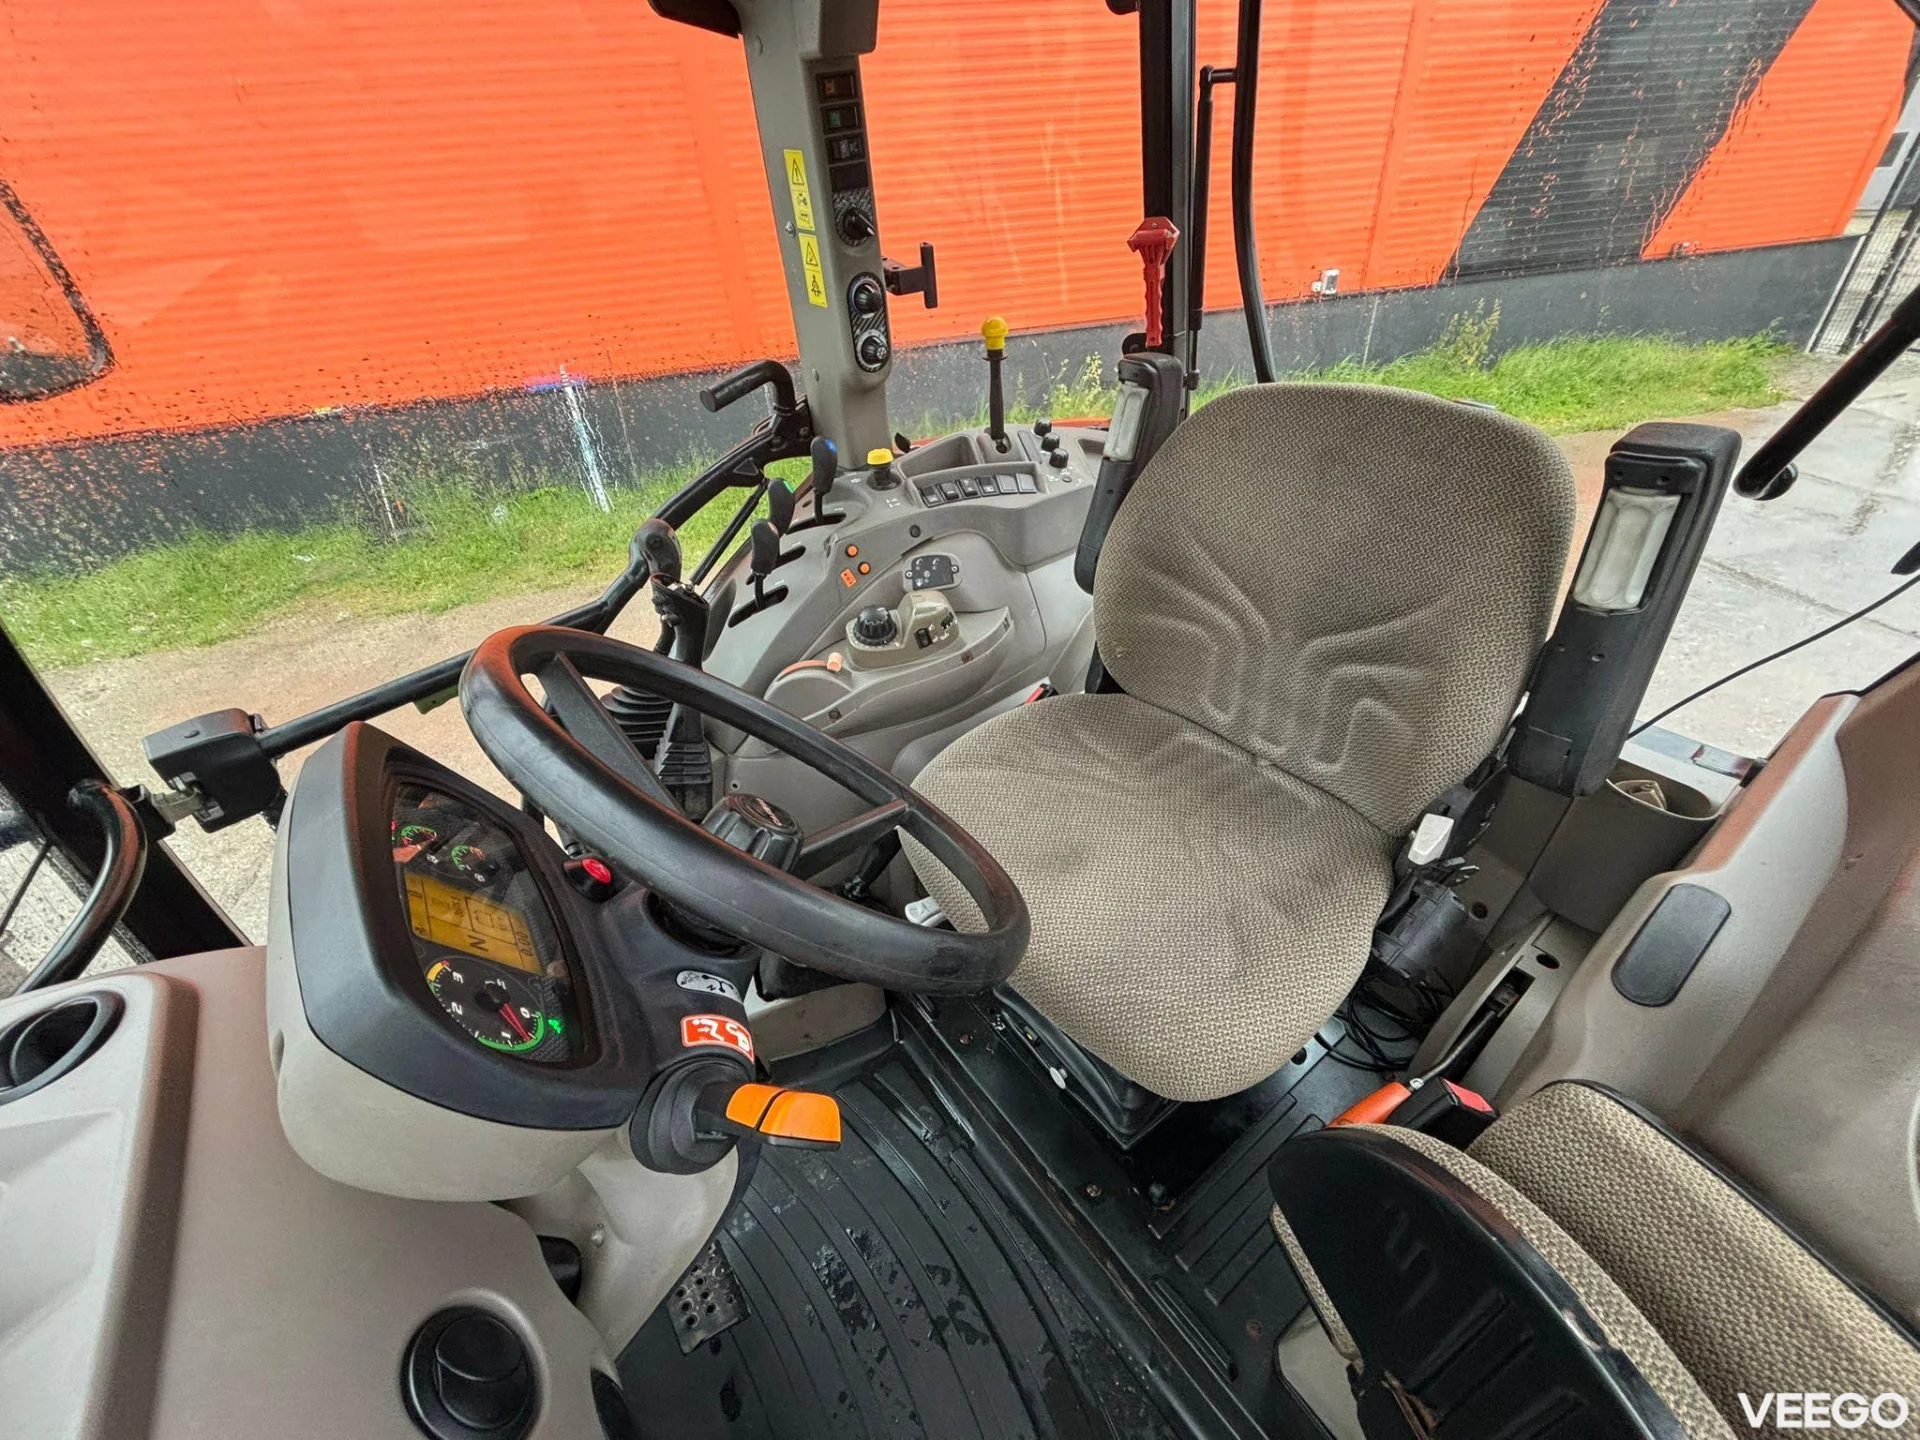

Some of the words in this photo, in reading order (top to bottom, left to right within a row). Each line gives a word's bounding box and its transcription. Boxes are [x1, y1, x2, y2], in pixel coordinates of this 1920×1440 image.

[467, 934, 489, 953] N
[452, 971, 464, 984] 3
[451, 1001, 463, 1016] 2
[519, 1006, 531, 1019] 0
[500, 1031, 512, 1040] 1
